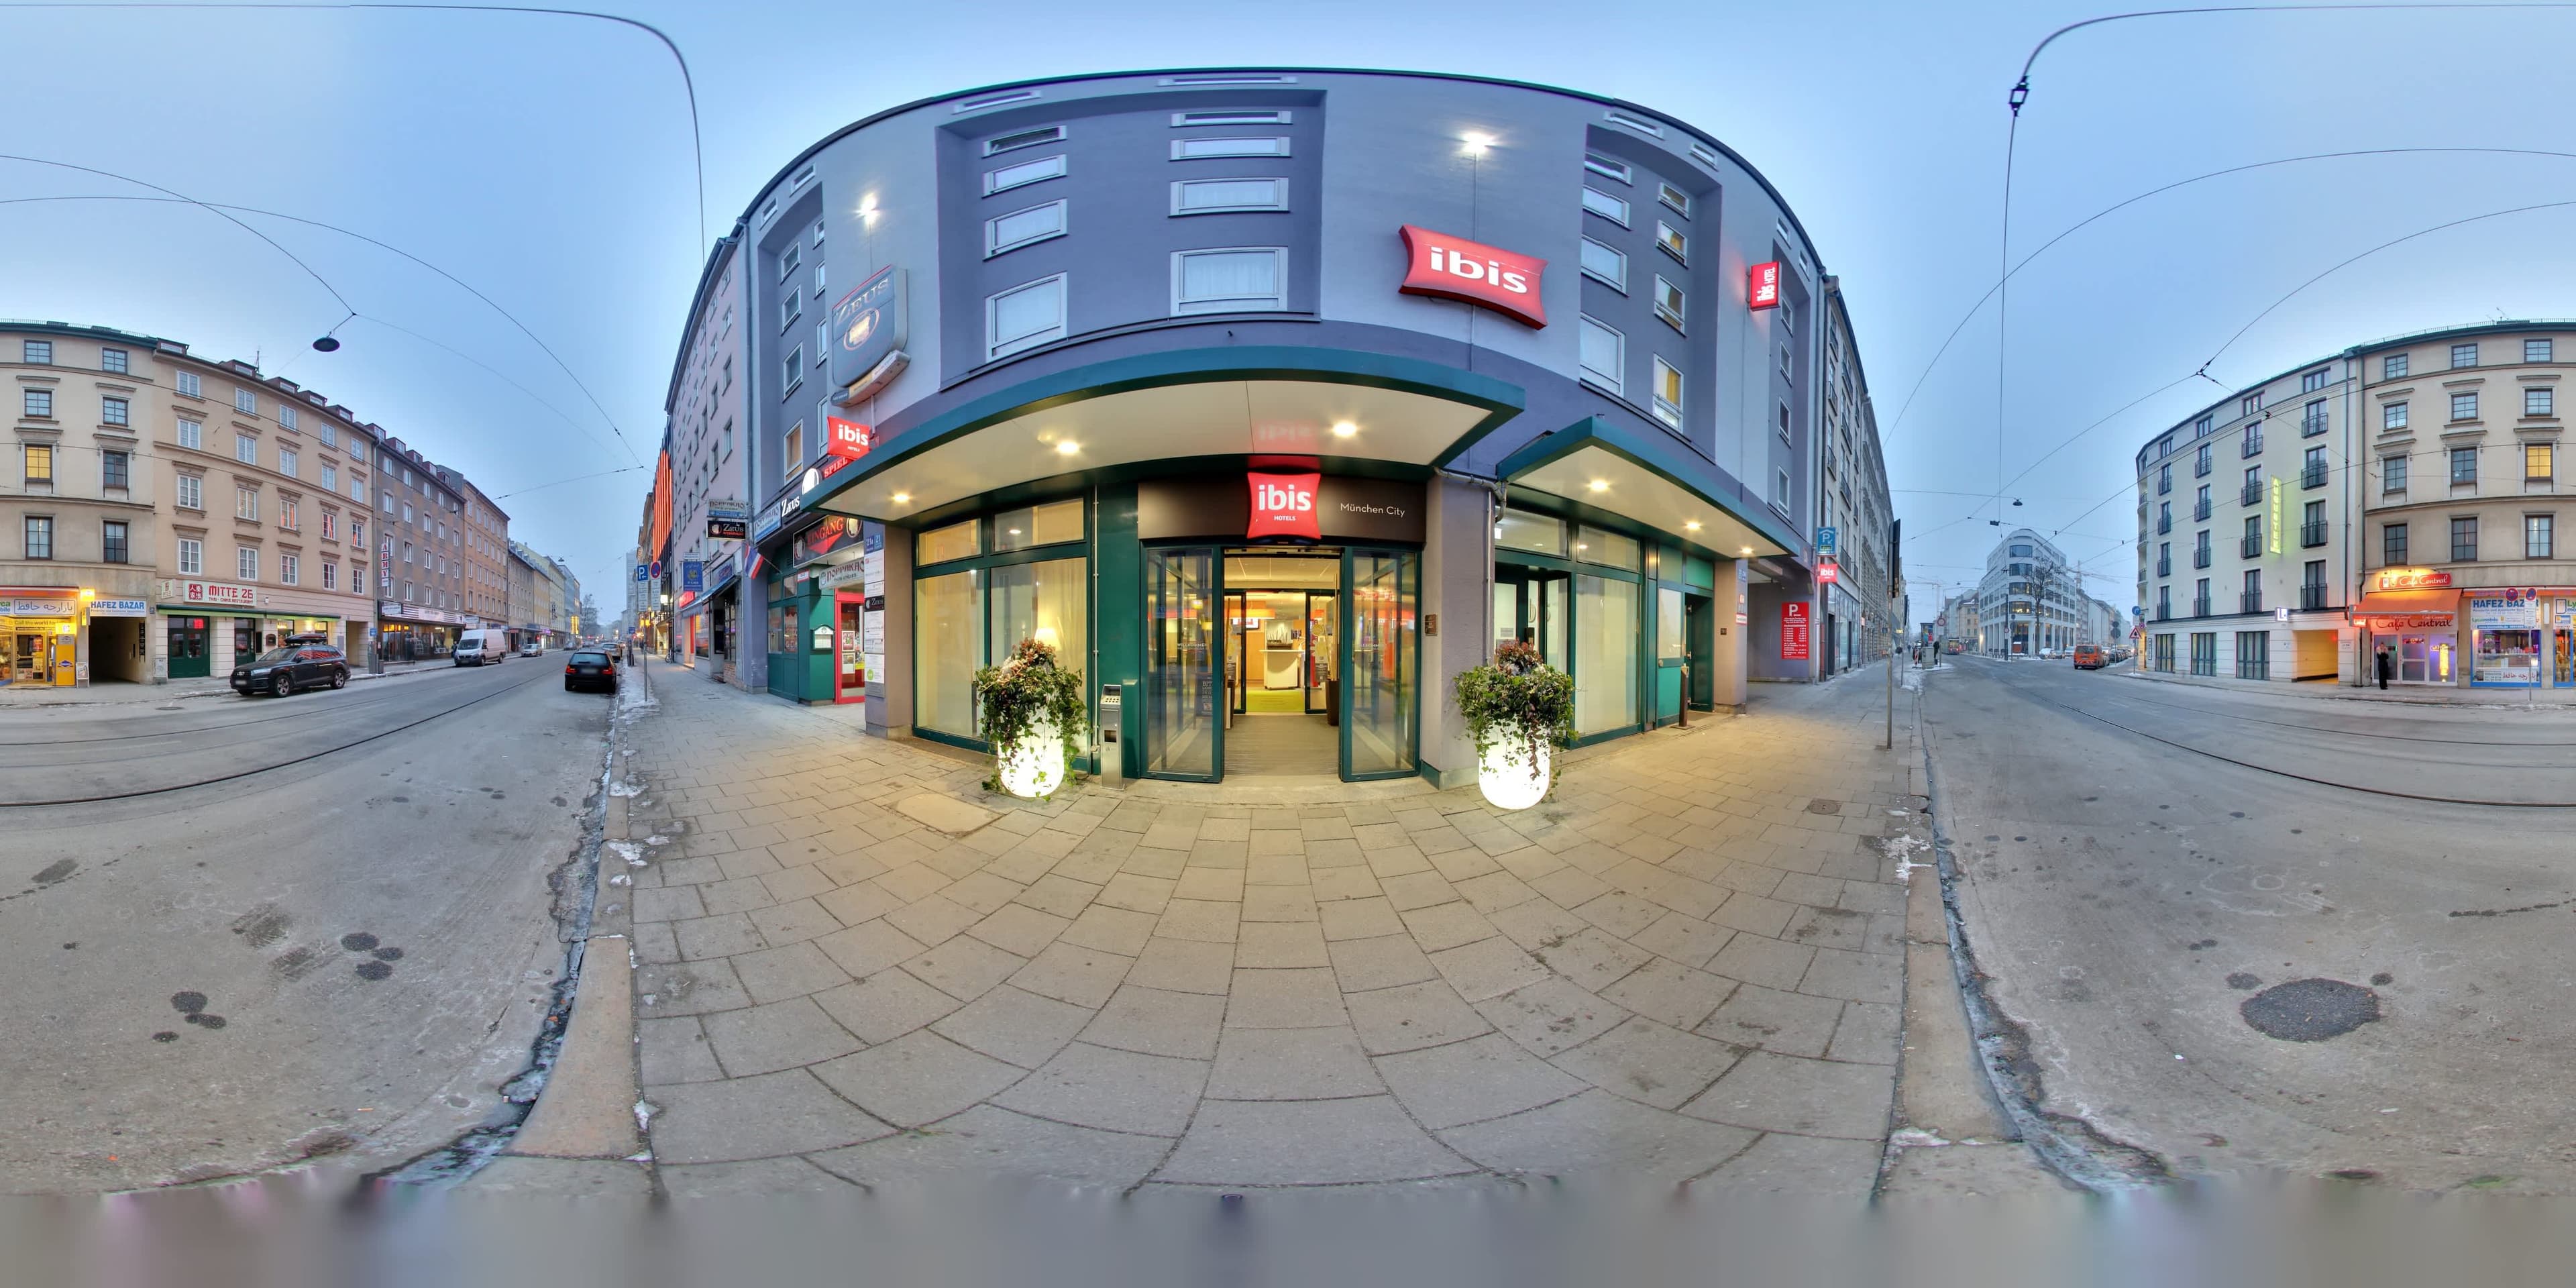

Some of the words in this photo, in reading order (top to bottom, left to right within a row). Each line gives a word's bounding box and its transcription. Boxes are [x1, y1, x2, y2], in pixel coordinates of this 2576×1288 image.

[1431, 246, 1527, 293] ibis
[1756, 284, 1776, 302] ibis
[838, 424, 869, 446] ibis
[1258, 484, 1311, 511] ibis
[1340, 503, 1384, 515] München
[1386, 506, 1405, 517] City
[639, 566, 645, 580] P
[1821, 568, 1835, 576] ibis
[2419, 575, 2448, 585] Central
[209, 585, 238, 598] MITTE
[241, 588, 254, 599] 26
[119, 602, 145, 610] BAZAR
[1789, 604, 1799, 616] P
[2473, 599, 2504, 608] HAFEZ
[2506, 599, 2539, 608] BAZ
[2376, 616, 2404, 631] Cafe
[2407, 616, 2453, 628] Central
